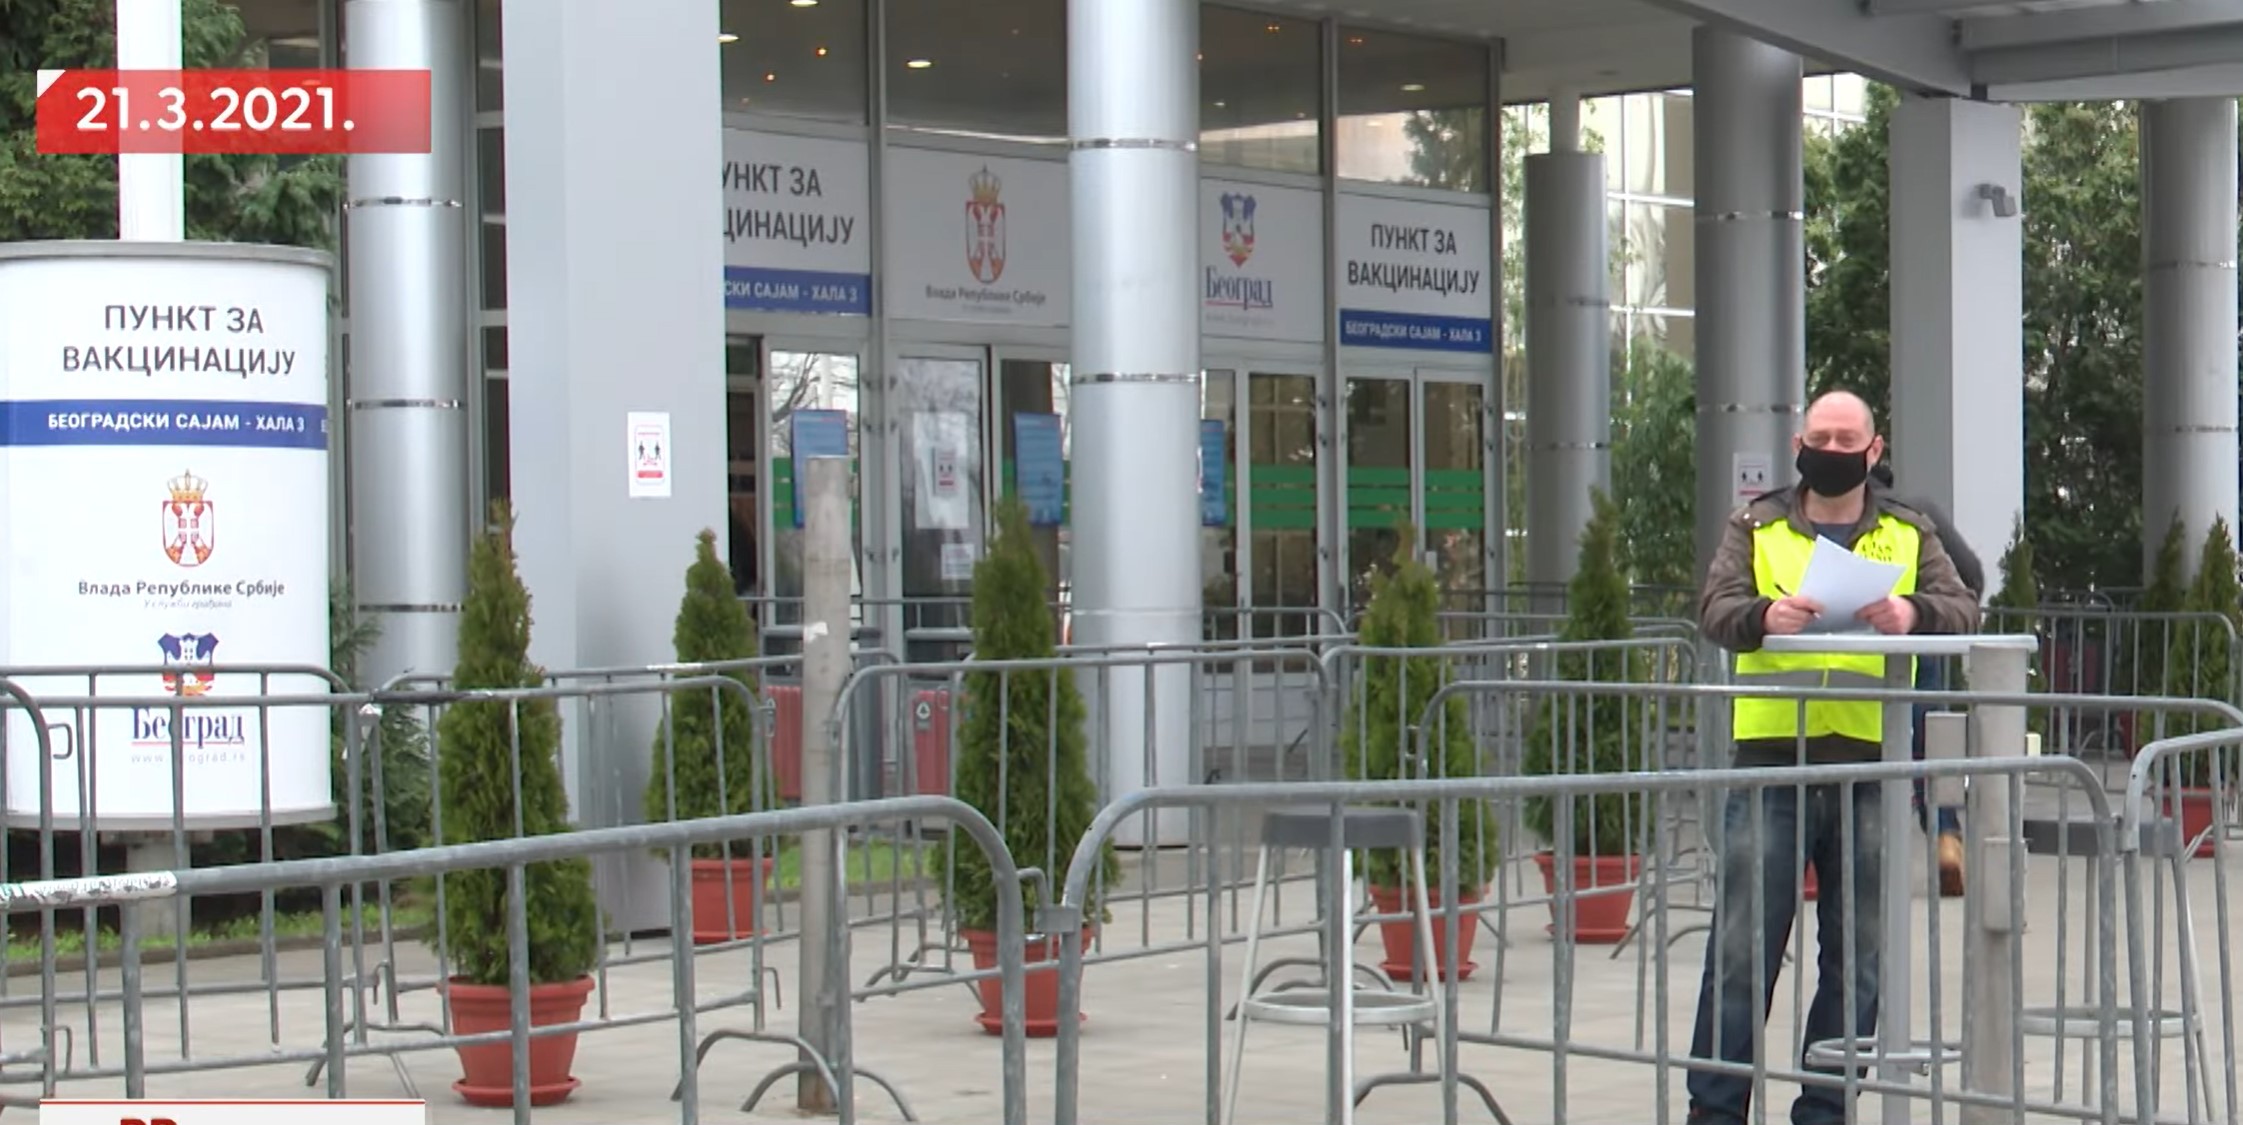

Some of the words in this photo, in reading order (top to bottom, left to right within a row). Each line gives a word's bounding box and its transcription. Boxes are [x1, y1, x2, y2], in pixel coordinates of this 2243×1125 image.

[722, 162, 782, 194] УНКТ
[790, 167, 822, 197] ЗА
[1371, 224, 1429, 252] ПУНКТ
[1434, 229, 1457, 255] ЗА
[754, 282, 799, 299] САЈАМ
[812, 285, 846, 301] ХАЛА
[850, 287, 858, 303] 3
[1206, 265, 1273, 310] Београд
[1348, 260, 1479, 298] ВАКЦИНАЦИЈУ
[105, 305, 217, 331] ПУНКТ
[227, 307, 264, 333] ЗА
[63, 346, 296, 379] ВАКЦИНАЦИЈУ
[48, 413, 170, 431] БЕОГРАДСКИ
[175, 413, 240, 430] САЈАМ
[256, 415, 295, 431] ХАЛА
[296, 417, 305, 432] 3
[78, 581, 131, 597] Влада
[136, 580, 232, 598] Републике
[236, 580, 285, 597] Србије
[131, 704, 245, 749] Беград
